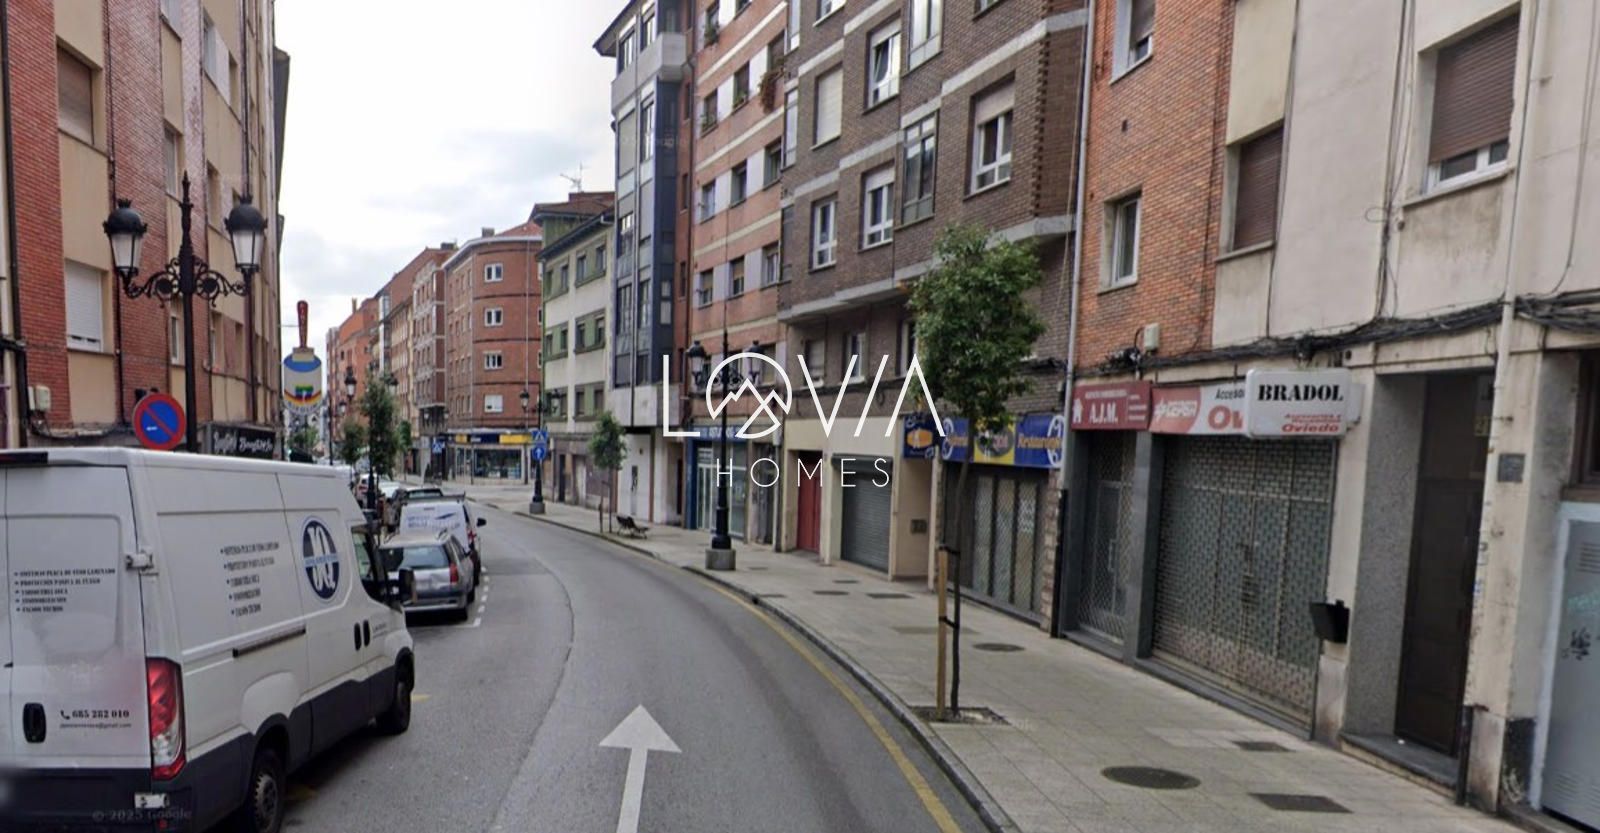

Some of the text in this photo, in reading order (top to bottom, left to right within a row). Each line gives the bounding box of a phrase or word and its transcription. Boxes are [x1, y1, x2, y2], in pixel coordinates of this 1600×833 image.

[1258, 384, 1344, 401] BRADOL
[1282, 423, 1339, 432] Oviedo
[72, 709, 130, 719] 685 282 010
